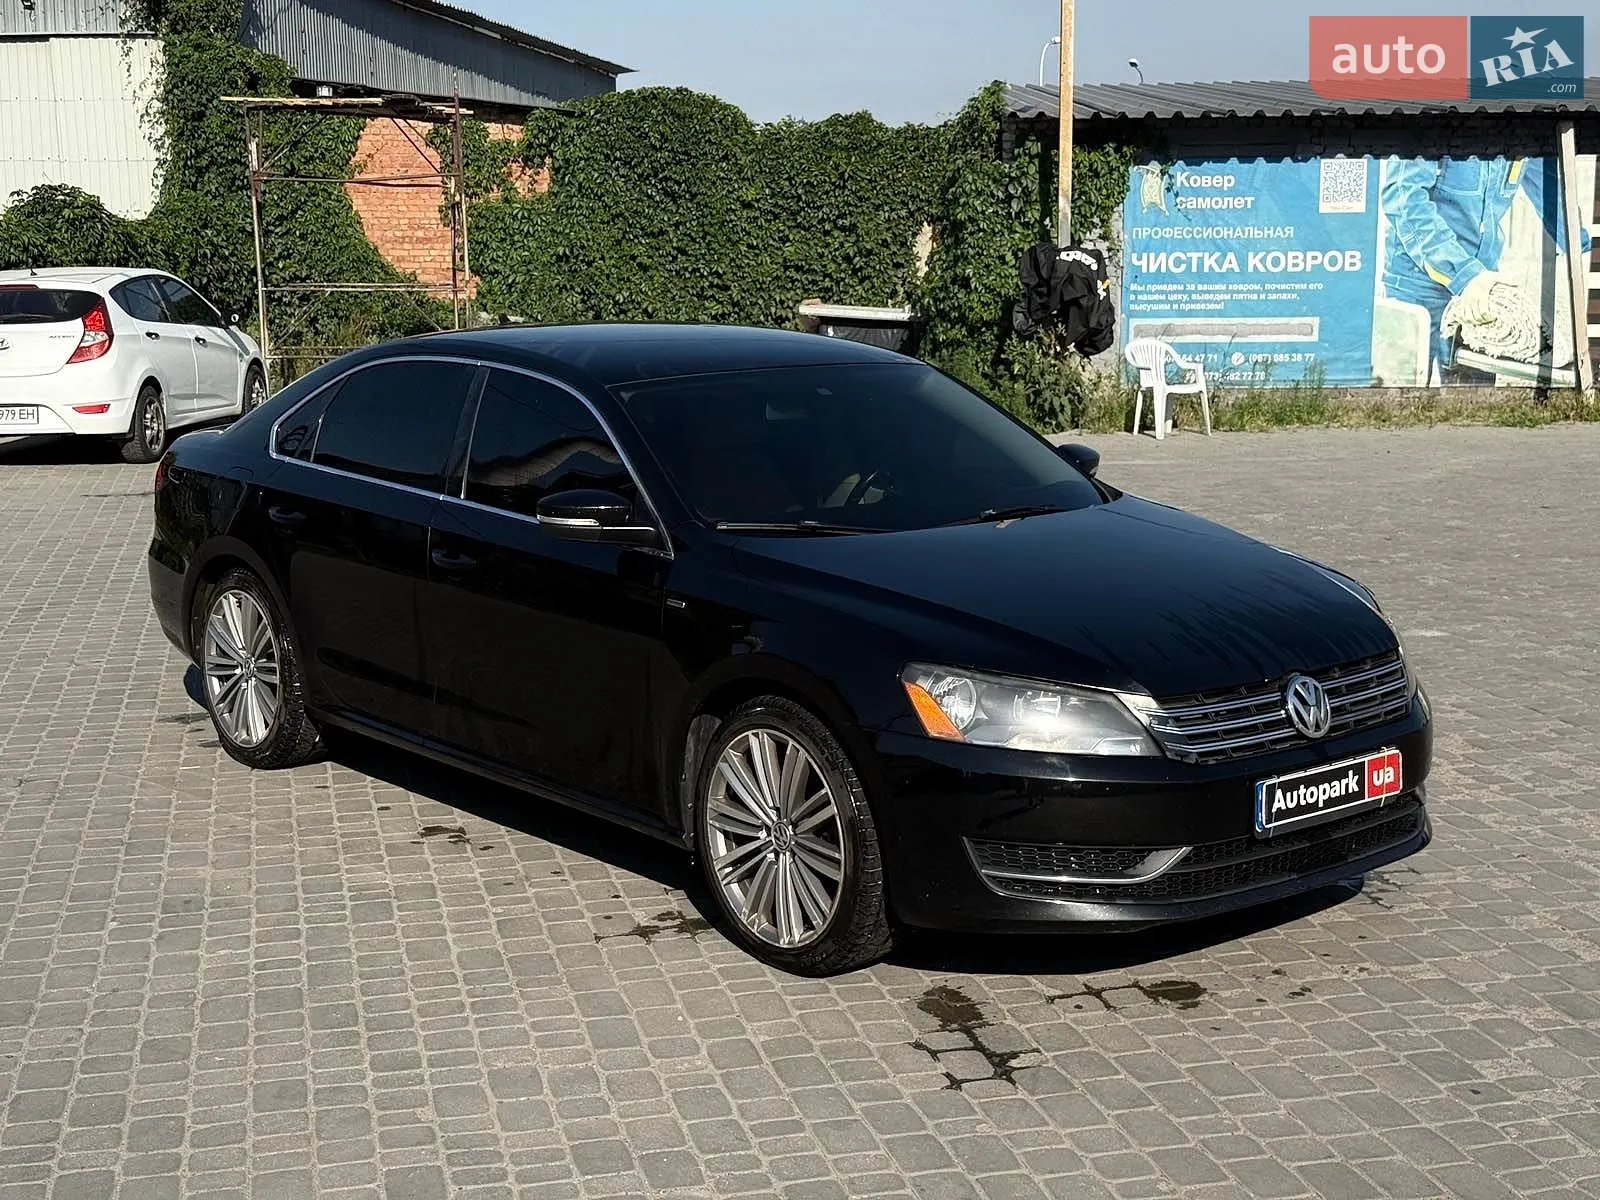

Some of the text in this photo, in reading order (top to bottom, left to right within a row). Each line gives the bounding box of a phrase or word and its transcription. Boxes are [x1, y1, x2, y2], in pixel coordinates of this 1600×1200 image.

[1176, 171, 1236, 191] Ковер
[1176, 196, 1256, 209] самолет
[1132, 226, 1294, 239] ПРОФЕССИОНАЛЬНАЯ
[1131, 250, 1362, 273] ЧИСТКА КОВРОВ
[1130, 283, 1145, 291] Мы
[1197, 283, 1226, 291] вашим
[1265, 282, 1307, 290] почистим
[1129, 303, 1171, 312] высушим
[1272, 766, 1395, 813] Autopark ua
